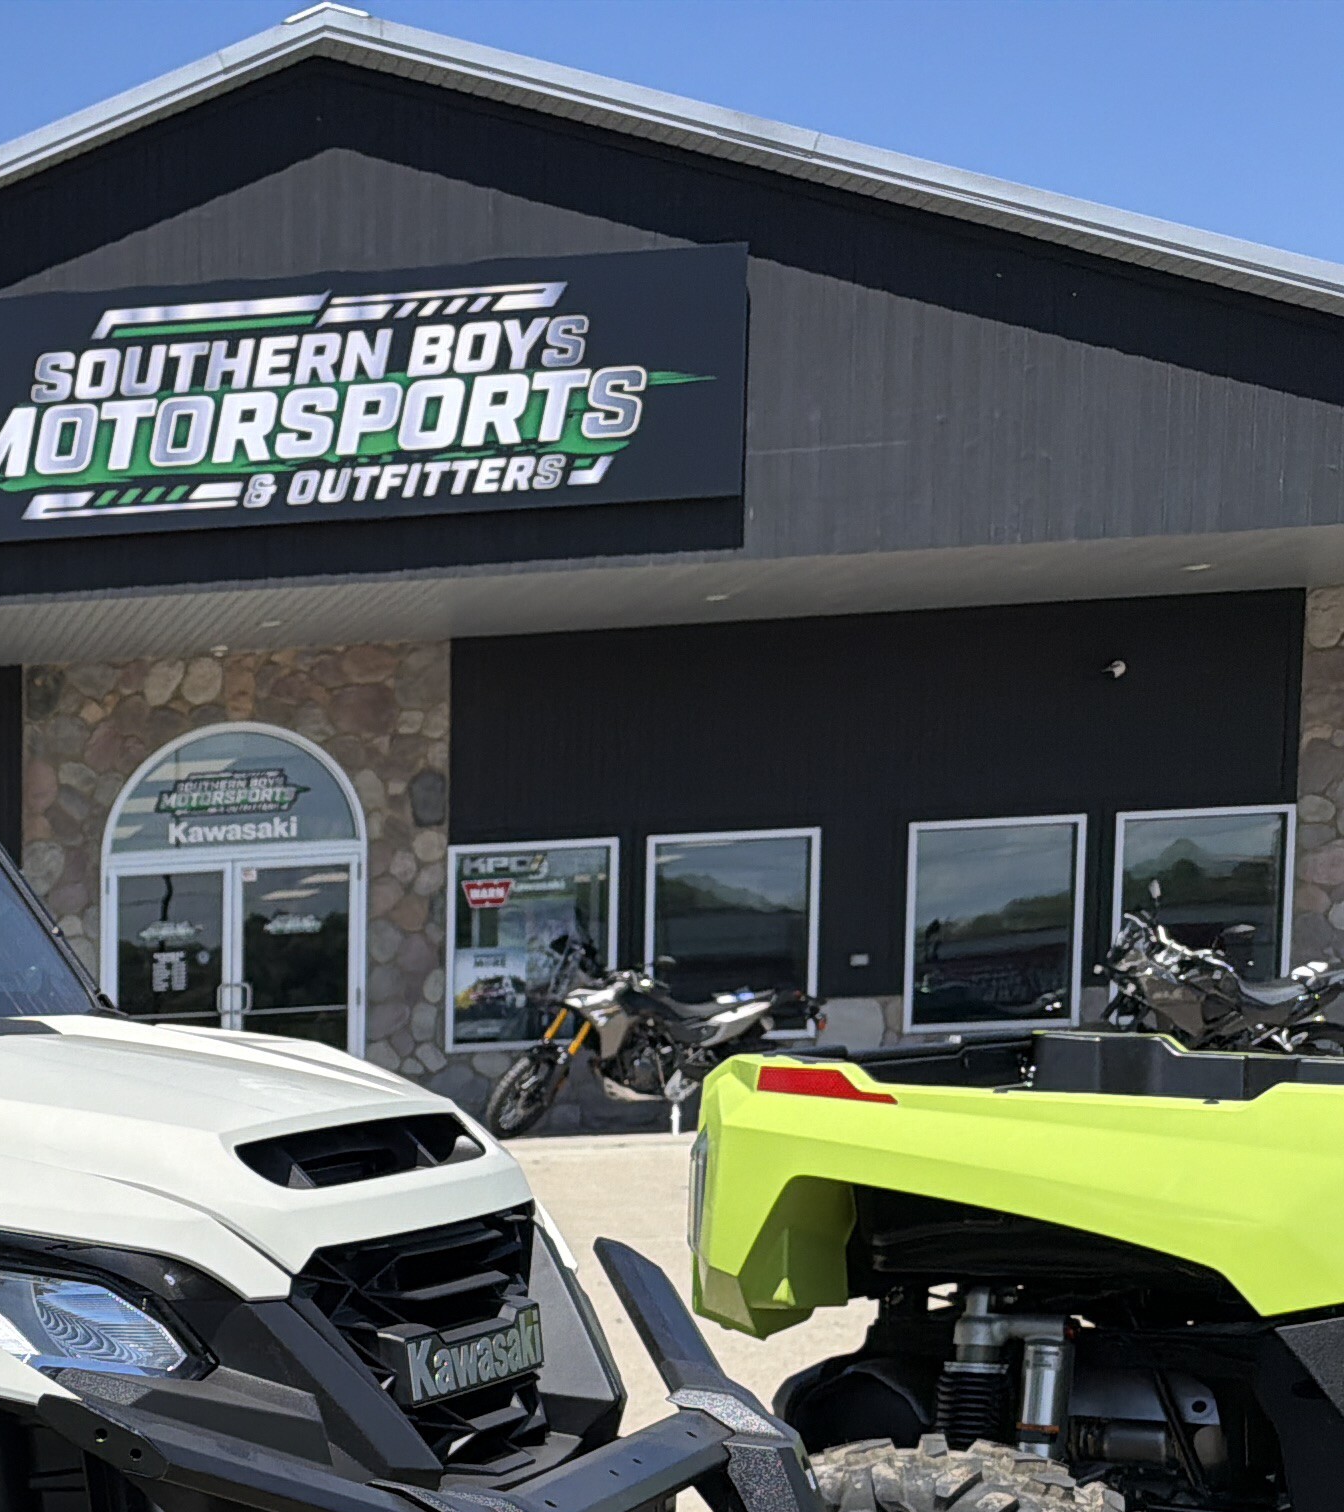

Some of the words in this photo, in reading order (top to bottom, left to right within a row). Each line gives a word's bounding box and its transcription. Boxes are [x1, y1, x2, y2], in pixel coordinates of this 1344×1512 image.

[31, 328, 390, 403] SOUTHERN
[407, 314, 590, 378] BOYS
[286, 454, 568, 503] OUTFITTERS
[160, 787, 297, 809] MOTORSPORTS
[176, 779, 247, 793] SOUTHERN
[168, 816, 298, 845] Kawasaki
[408, 1309, 543, 1401] Kawasaki
